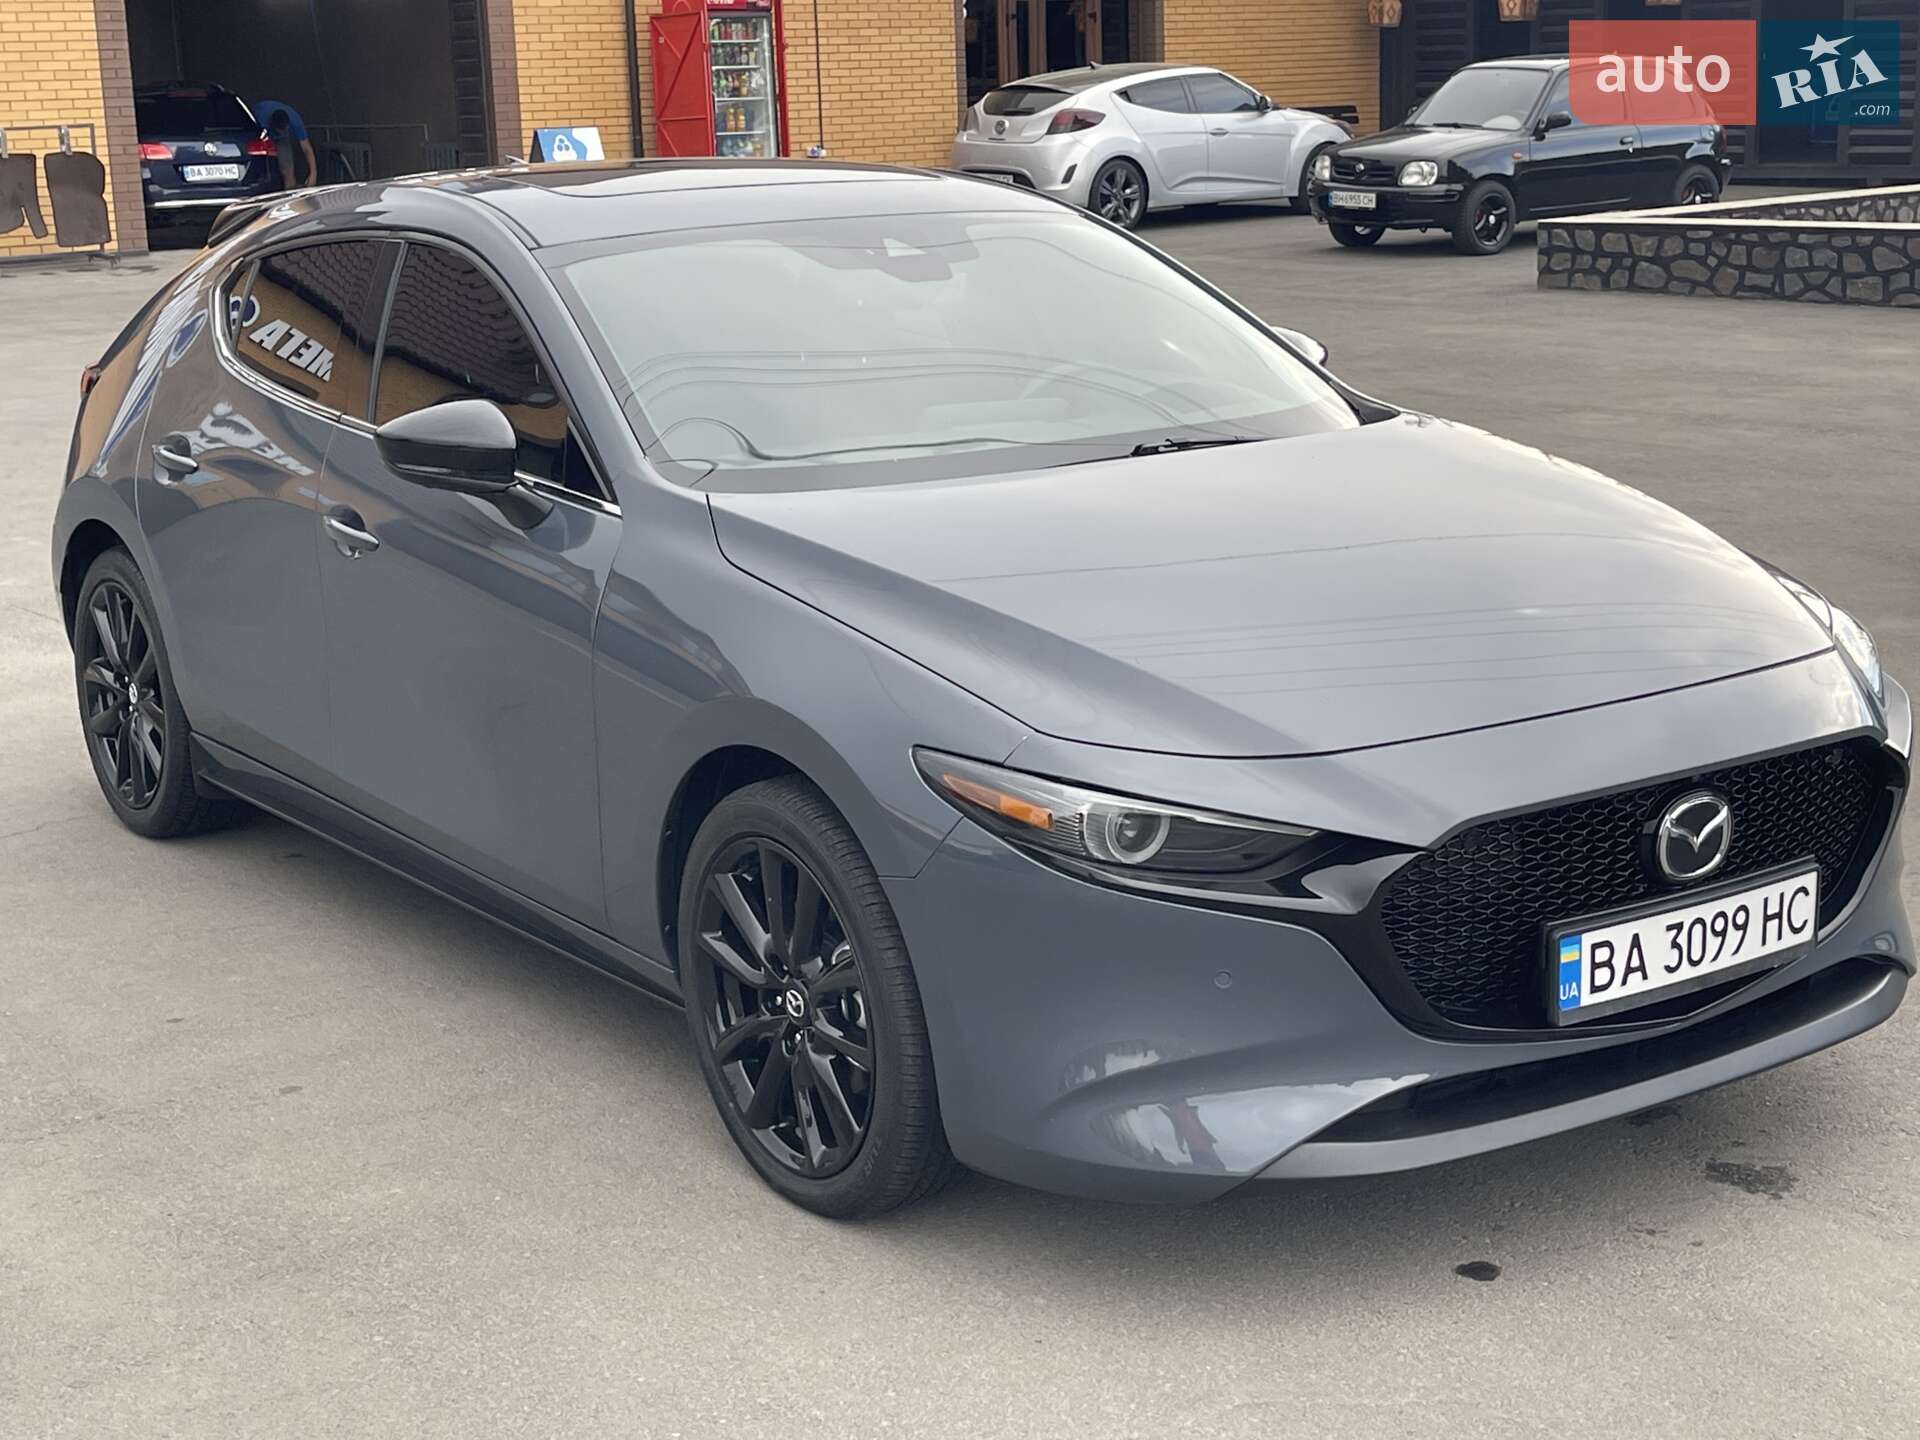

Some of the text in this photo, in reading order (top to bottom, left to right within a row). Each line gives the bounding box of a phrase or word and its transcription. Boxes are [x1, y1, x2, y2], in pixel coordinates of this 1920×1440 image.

[1590, 886, 1810, 995] BA 3099 HC
[1559, 984, 1579, 1000] UA
